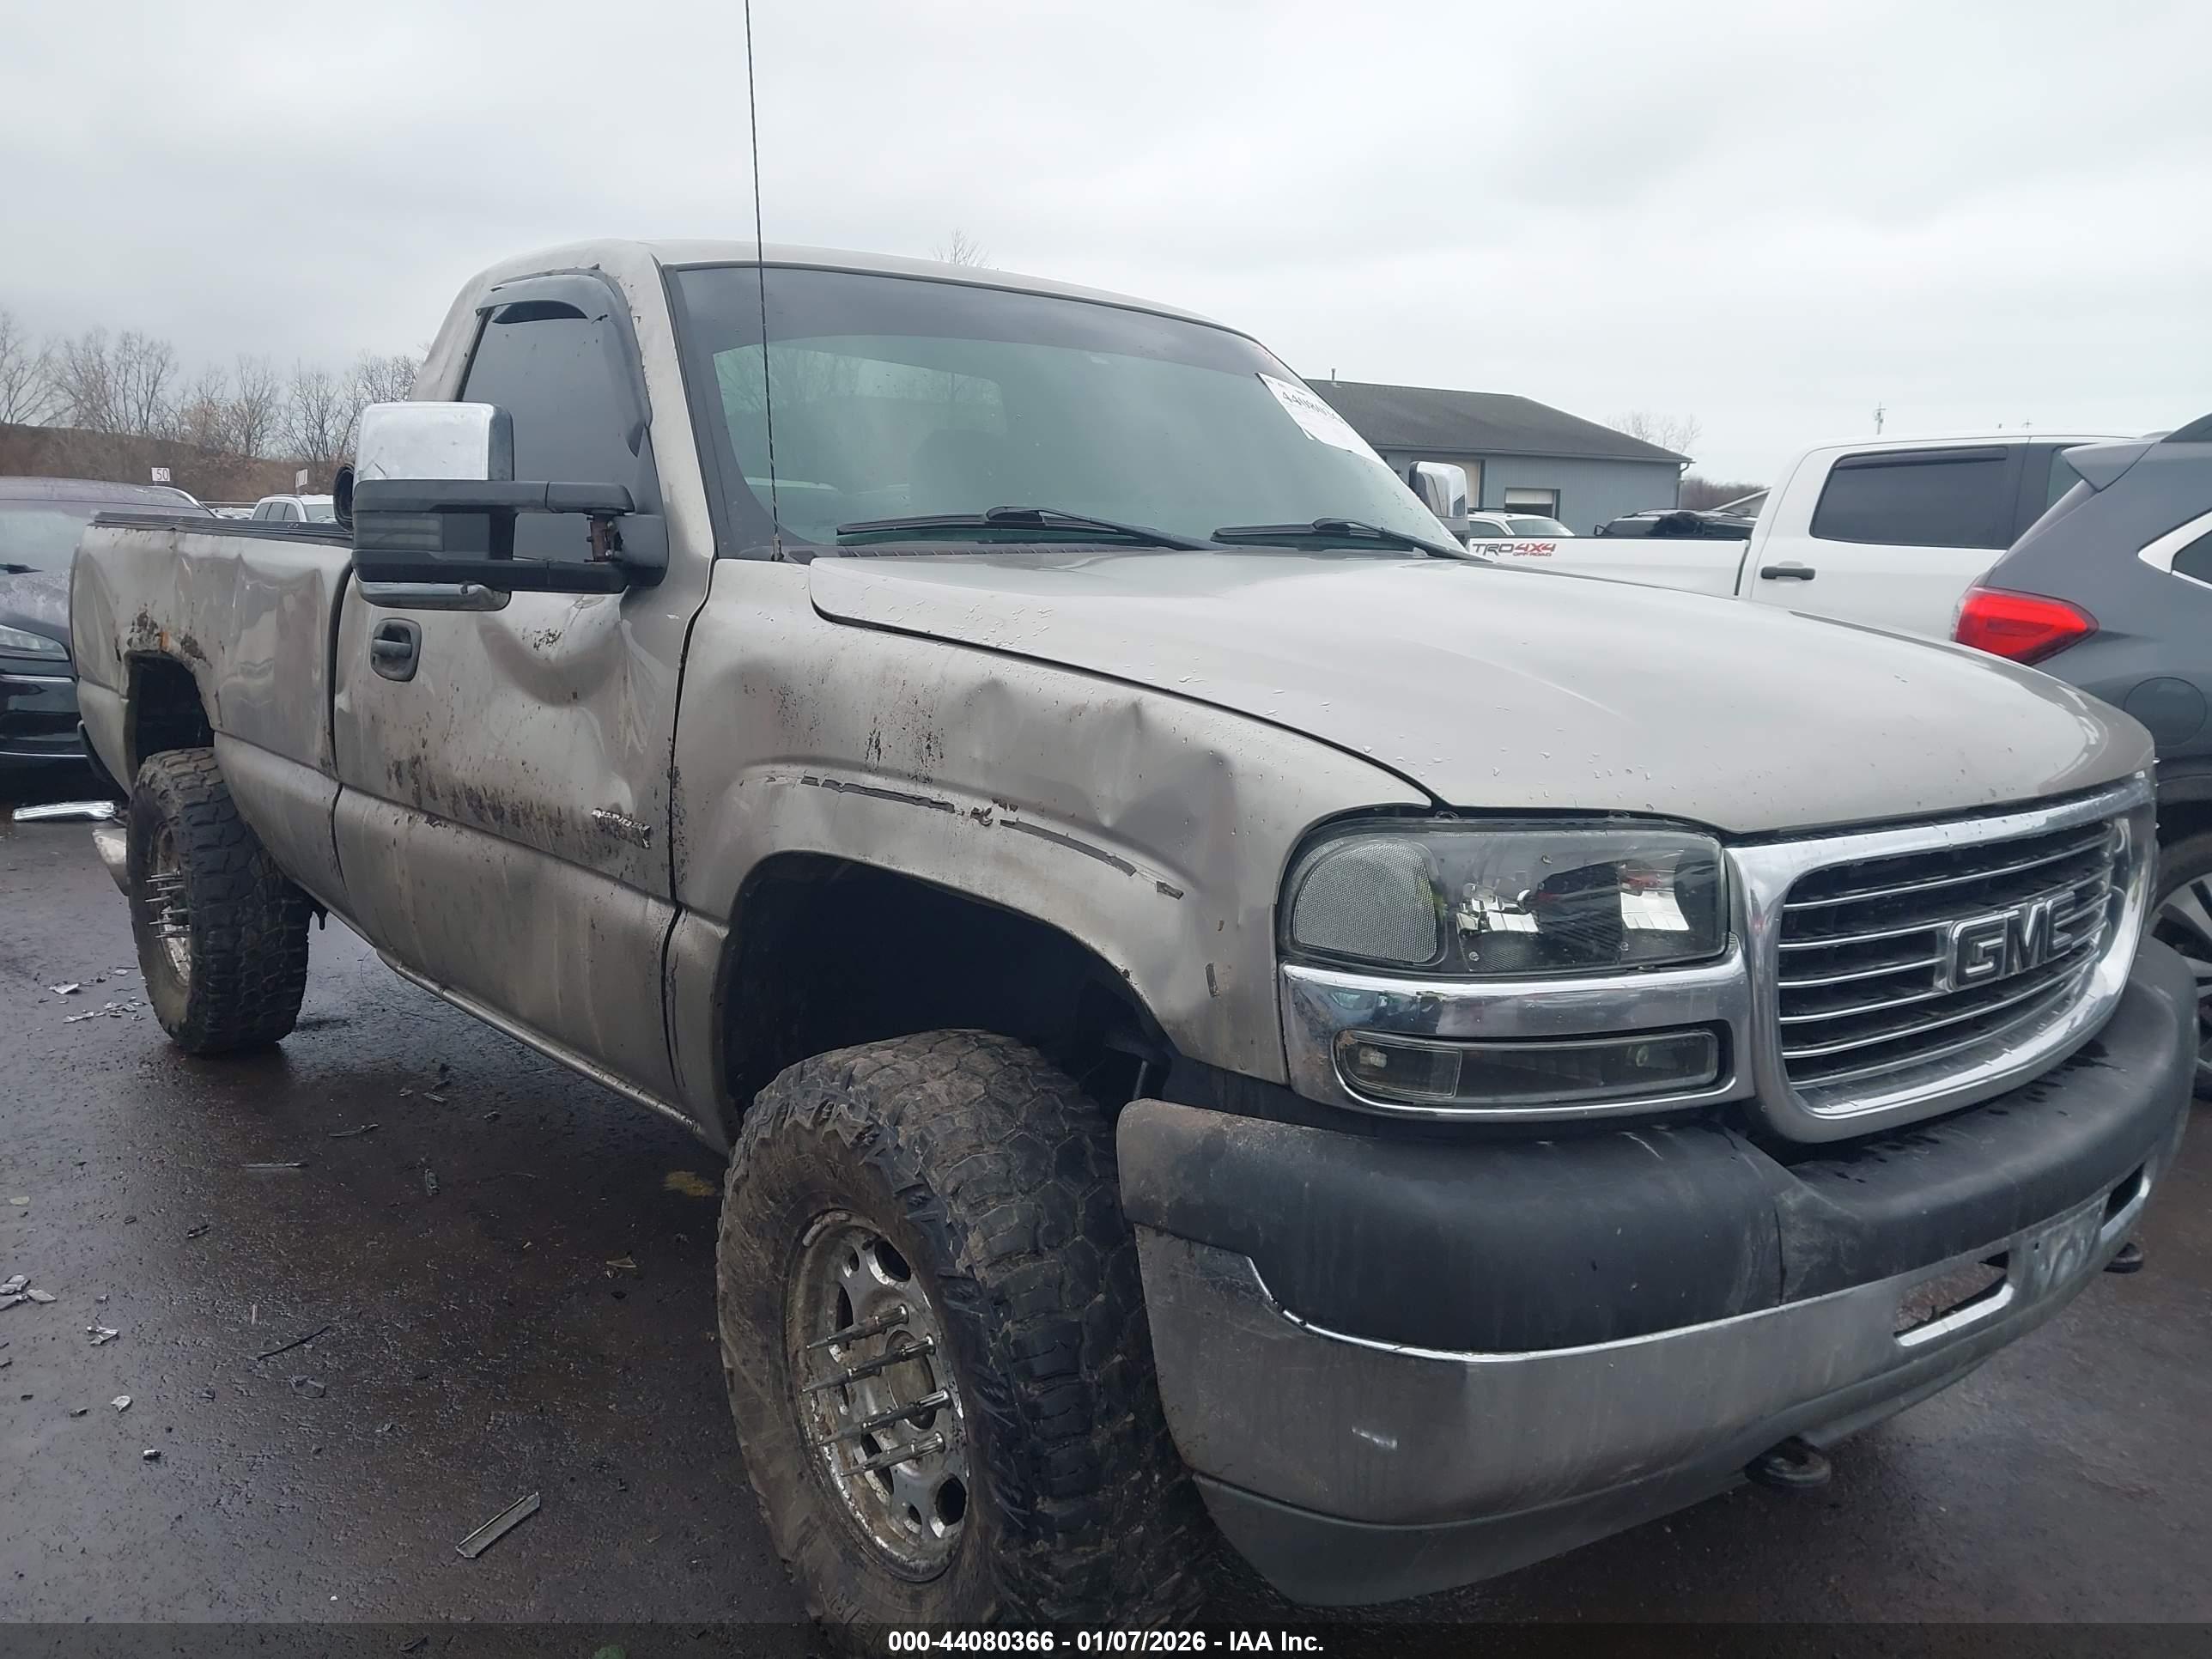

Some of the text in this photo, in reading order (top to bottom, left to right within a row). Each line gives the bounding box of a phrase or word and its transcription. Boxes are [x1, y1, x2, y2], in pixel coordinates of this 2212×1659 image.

[156, 468, 169, 481] 50
[1472, 543, 1514, 556] TRD
[1949, 891, 2075, 989] GMC
